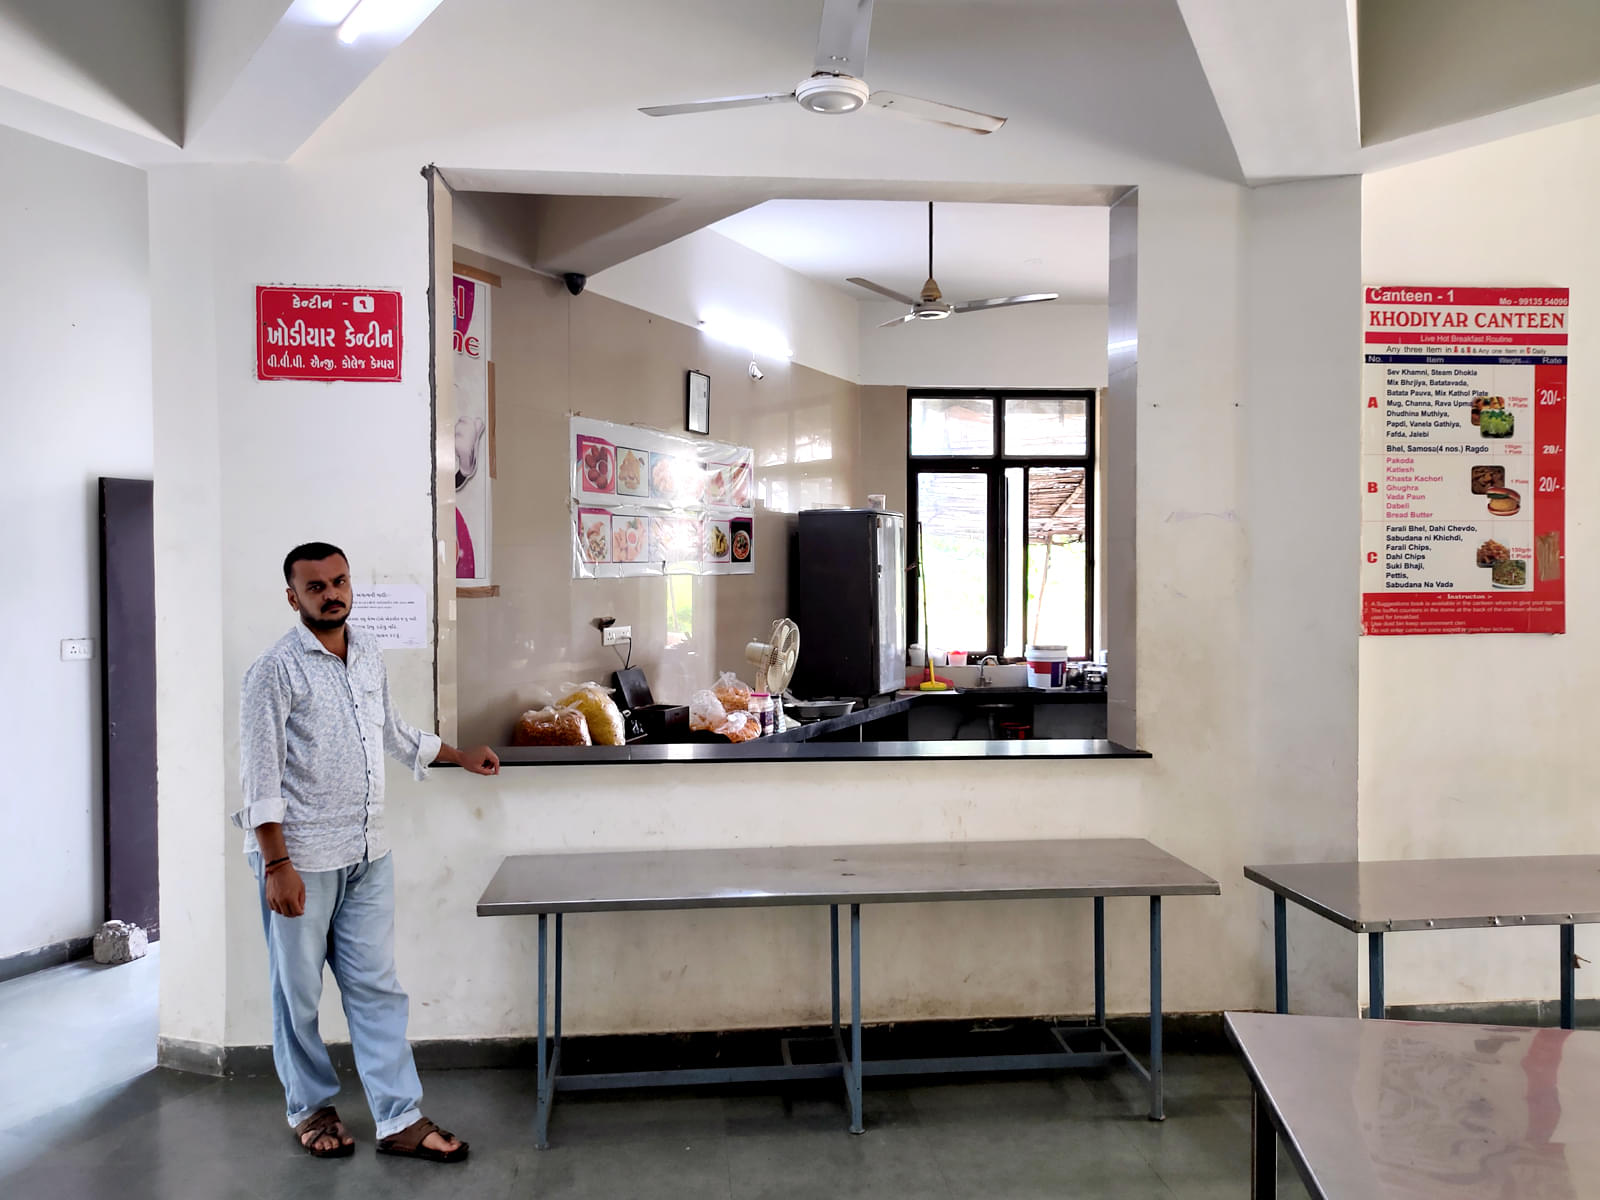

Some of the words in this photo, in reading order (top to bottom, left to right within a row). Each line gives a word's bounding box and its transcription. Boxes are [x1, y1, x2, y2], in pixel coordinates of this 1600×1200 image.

[292, 294, 332, 309] કેન્ટીન
[1371, 288, 1432, 302] Canteen
[1447, 290, 1454, 302] 1
[1370, 310, 1468, 327] KHODIYAR
[1474, 312, 1564, 328] CANTEEN
[267, 318, 335, 347] ખોડીયાર
[344, 320, 393, 348] કેન્ટીન
[1386, 346, 1400, 354] Any
[1368, 396, 1378, 408] A
[1540, 390, 1561, 405] 20/-
[1368, 482, 1378, 493] B
[1539, 477, 1560, 492] 20/-
[1367, 552, 1378, 563] C
